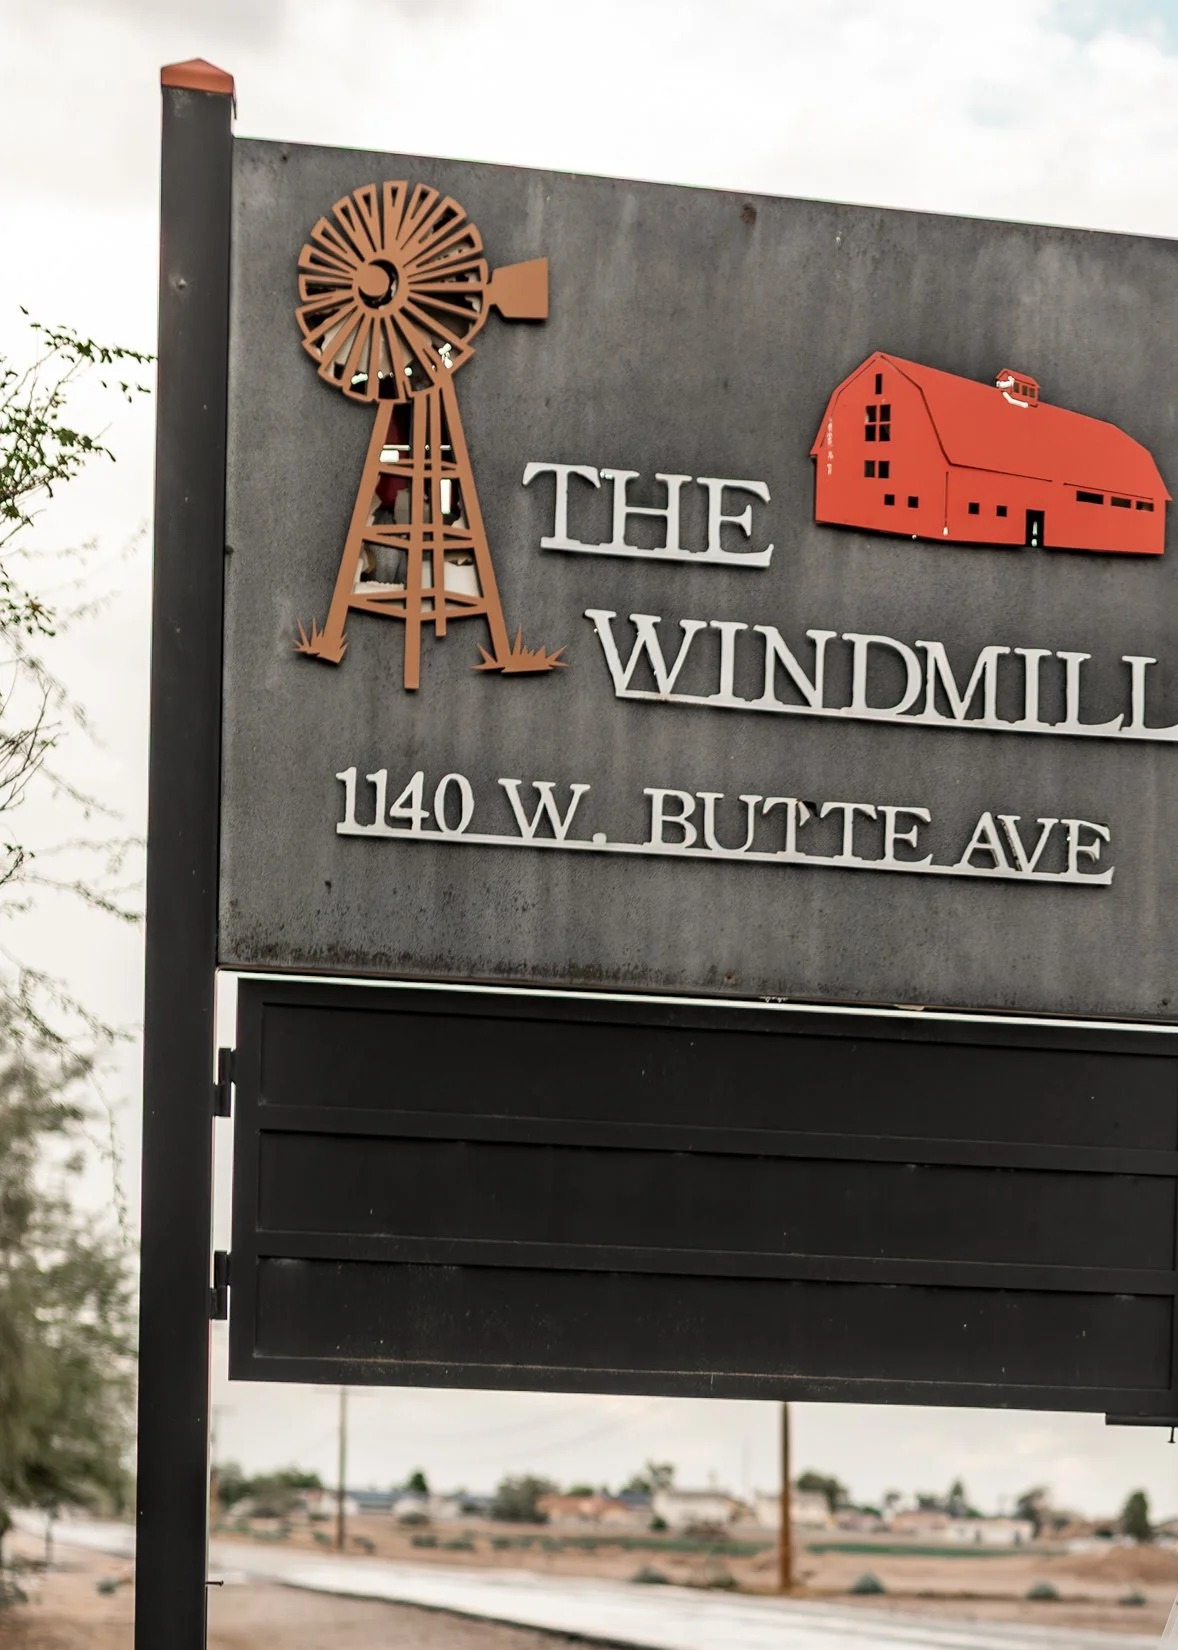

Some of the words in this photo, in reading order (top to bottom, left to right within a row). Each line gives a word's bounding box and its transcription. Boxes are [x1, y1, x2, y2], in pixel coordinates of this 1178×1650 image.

[522, 461, 774, 566] THE
[335, 766, 475, 838] 1140
[497, 777, 608, 846] W.
[643, 787, 934, 867] BUTTE
[957, 812, 1115, 884] AVE
